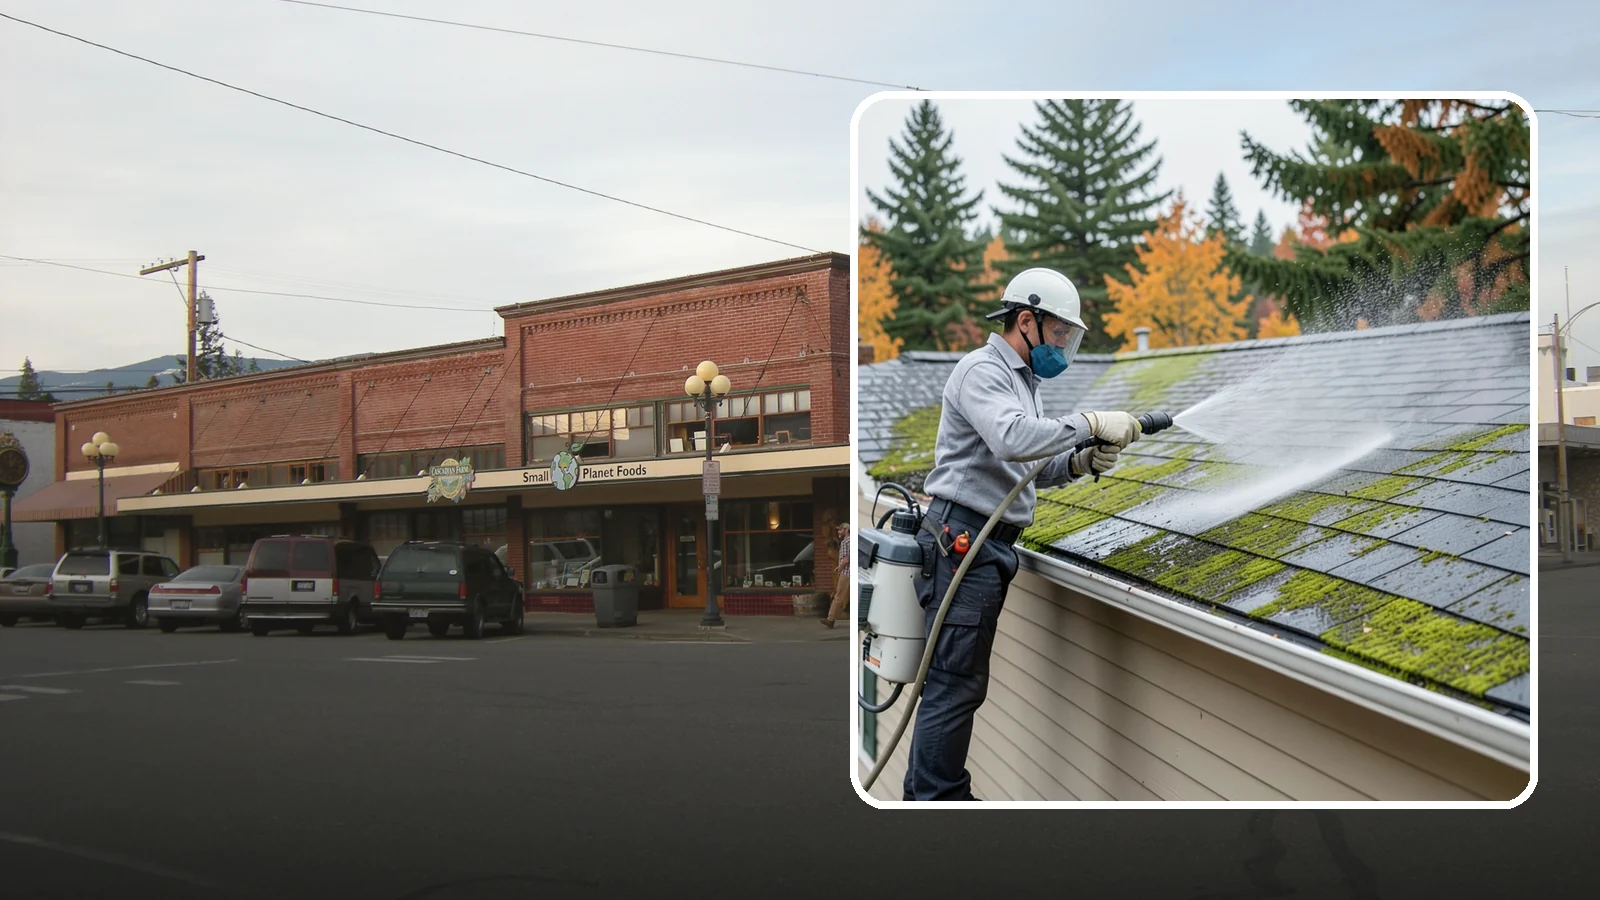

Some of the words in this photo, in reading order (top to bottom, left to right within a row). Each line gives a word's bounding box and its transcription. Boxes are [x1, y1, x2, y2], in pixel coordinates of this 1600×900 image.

[523, 471, 549, 483] Small
[583, 467, 614, 479] Planet
[617, 464, 647, 477] Foods
